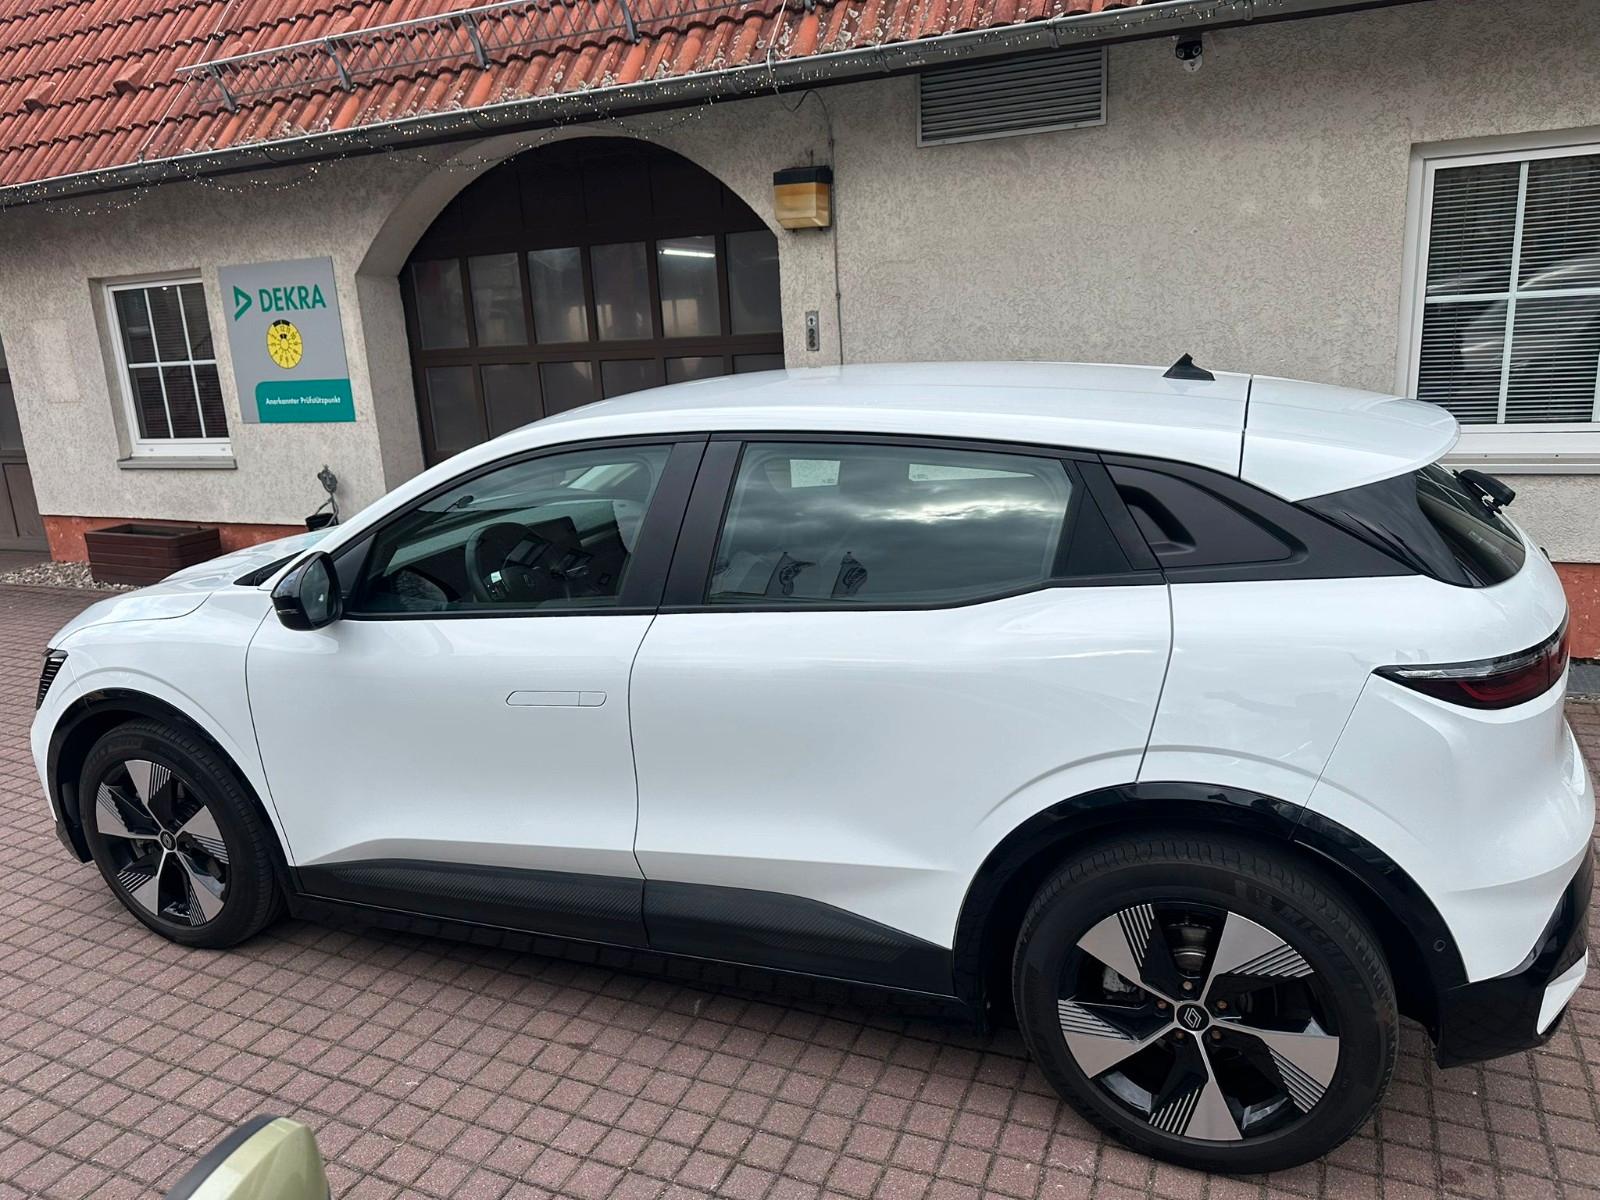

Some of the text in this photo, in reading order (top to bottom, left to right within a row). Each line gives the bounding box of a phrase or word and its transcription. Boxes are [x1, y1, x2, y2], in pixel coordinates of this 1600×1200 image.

[258, 284, 327, 312] DEKRA
[266, 395, 341, 406] Anerkannter Prüfstützpunkt
